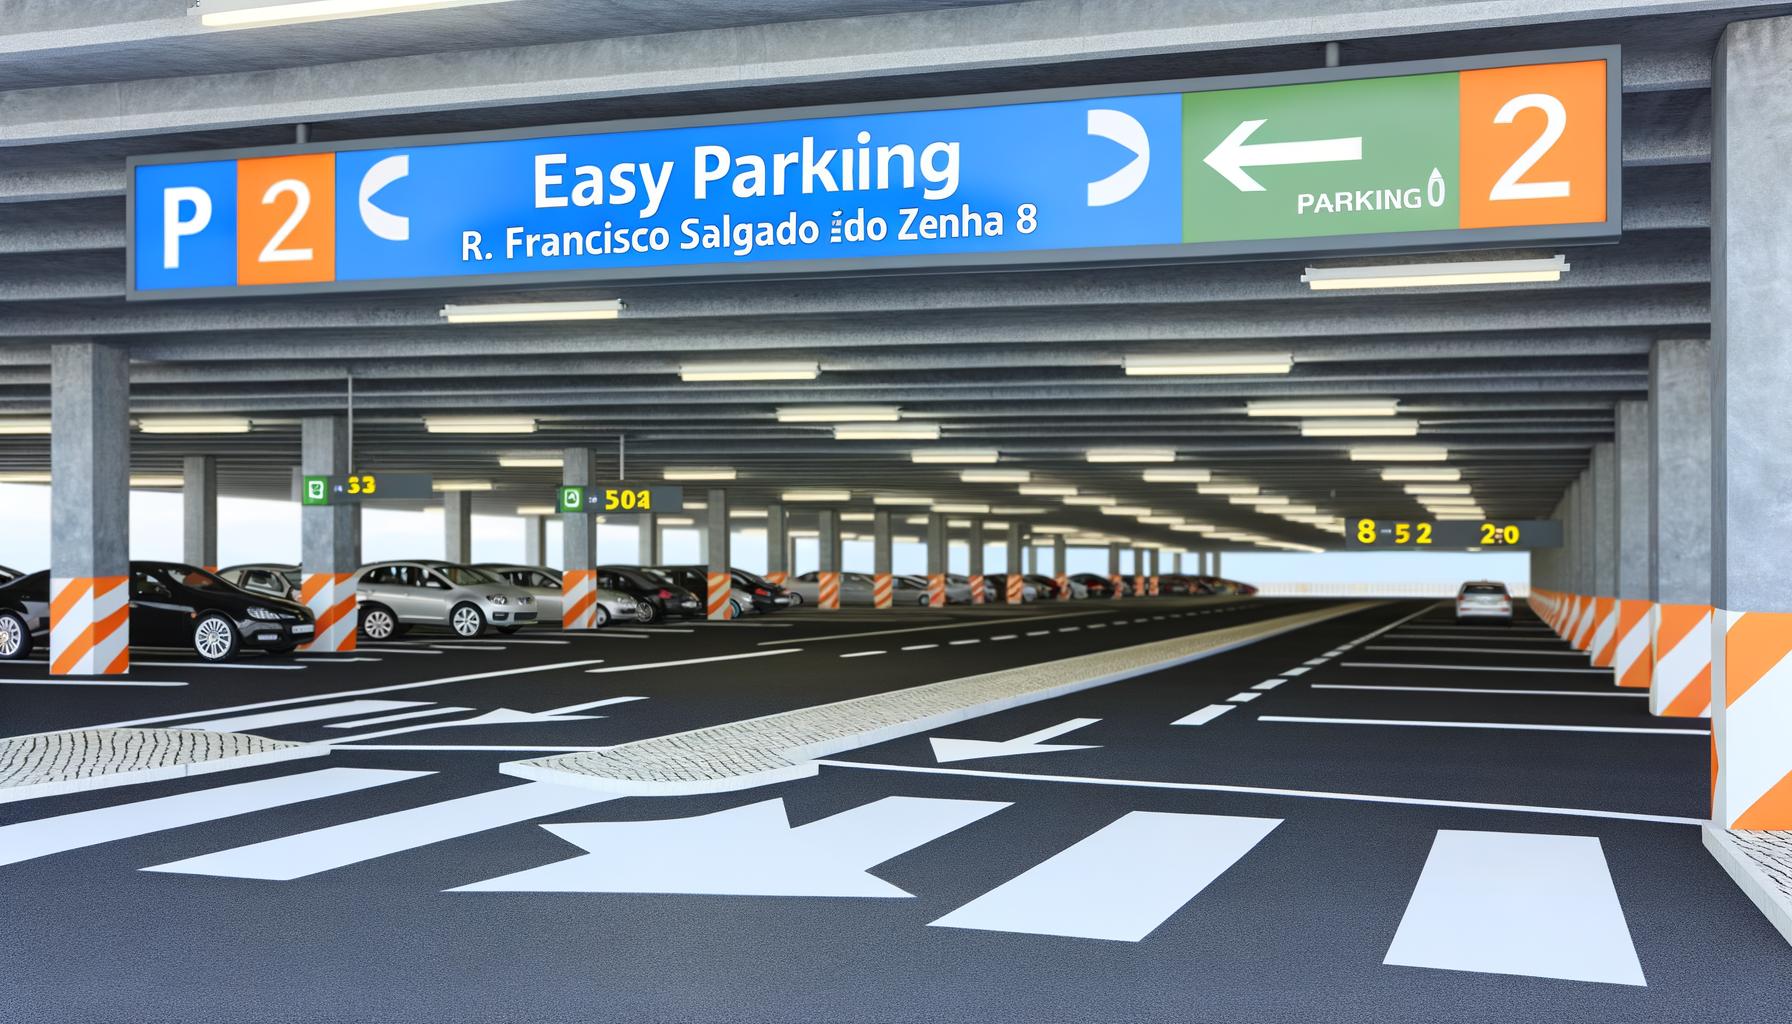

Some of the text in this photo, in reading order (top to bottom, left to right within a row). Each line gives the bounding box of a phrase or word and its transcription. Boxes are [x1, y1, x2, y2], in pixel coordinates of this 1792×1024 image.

[1488, 93, 1571, 201] 2
[534, 153, 674, 219] Easy
[1297, 188, 1422, 215] PARKING
[163, 179, 313, 269] P 2
[462, 230, 493, 261] R.
[506, 226, 670, 259] Francisco
[680, 214, 819, 256] Salgado
[897, 203, 1003, 242] Zenha
[1016, 203, 1037, 234] 8
